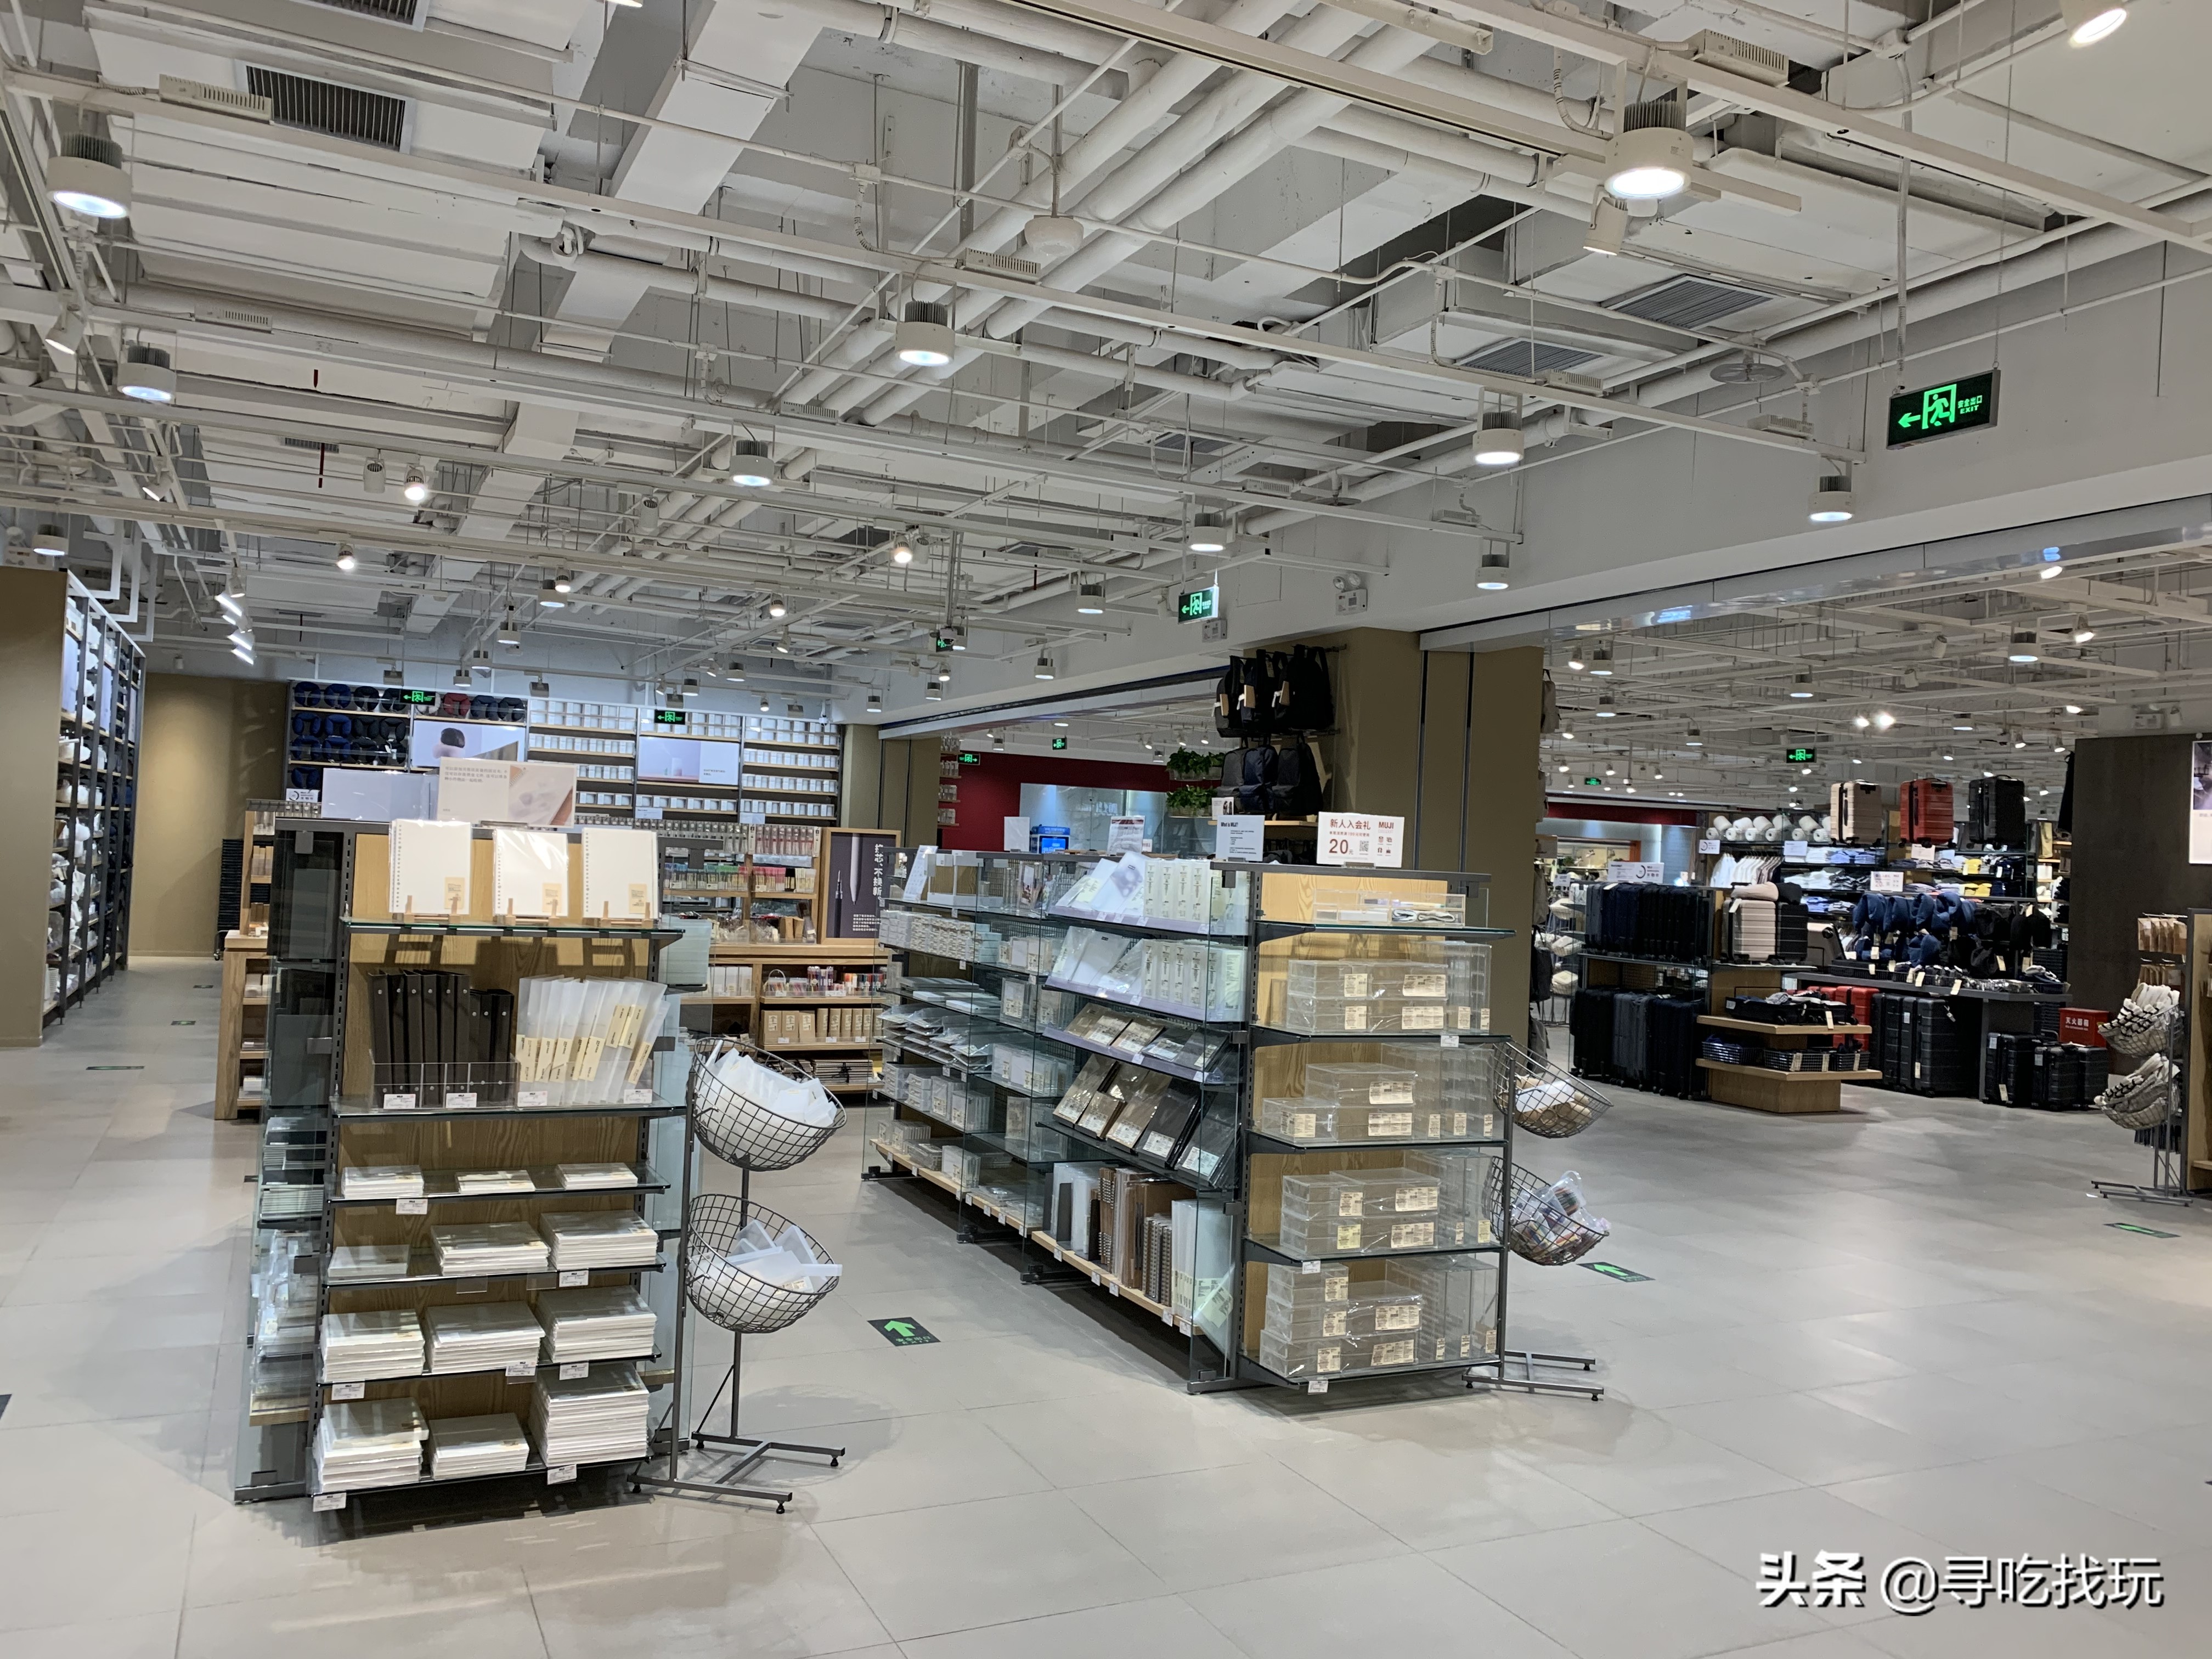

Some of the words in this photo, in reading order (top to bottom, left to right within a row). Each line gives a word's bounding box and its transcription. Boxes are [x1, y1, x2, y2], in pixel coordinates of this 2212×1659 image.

[1957, 394, 1983, 409] 安全出口
[1960, 404, 1979, 414] EXIT
[1330, 819, 1371, 830] 新人入会礼
[1378, 821, 1394, 830] MUJI
